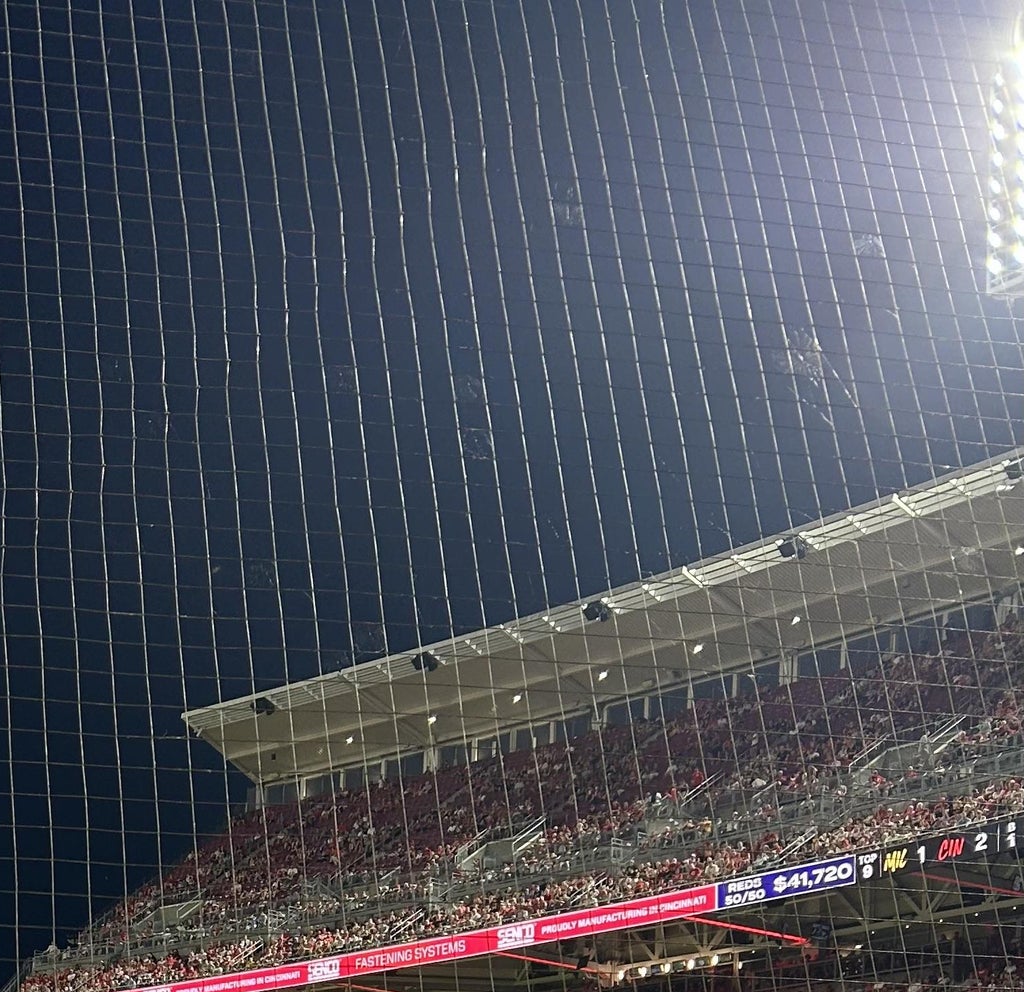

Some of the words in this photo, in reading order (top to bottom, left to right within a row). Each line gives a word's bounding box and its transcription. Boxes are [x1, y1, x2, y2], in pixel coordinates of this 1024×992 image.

[858, 853, 877, 866] TOP
[883, 848, 907, 872] MIL
[917, 846, 925, 864] 1
[937, 837, 964, 861] CIN
[975, 832, 988, 851] 2
[1006, 833, 1015, 848] 1
[728, 877, 762, 893] REDS
[773, 862, 852, 894] $41,720
[862, 864, 874, 879] 9
[724, 888, 766, 906] 50/50
[497, 925, 535, 944] SENCO
[541, 922, 577, 935] PROUDLY
[578, 907, 648, 929] MANUFACTURING
[649, 906, 660, 914] IN
[660, 895, 707, 912] CINCINNATI
[307, 961, 340, 979] SENCO
[355, 949, 413, 969] FASTENING
[414, 940, 466, 960] SYSTEMS
[203, 979, 256, 992] MANUFACTURING
[264, 971, 300, 984] CINCINNATI
